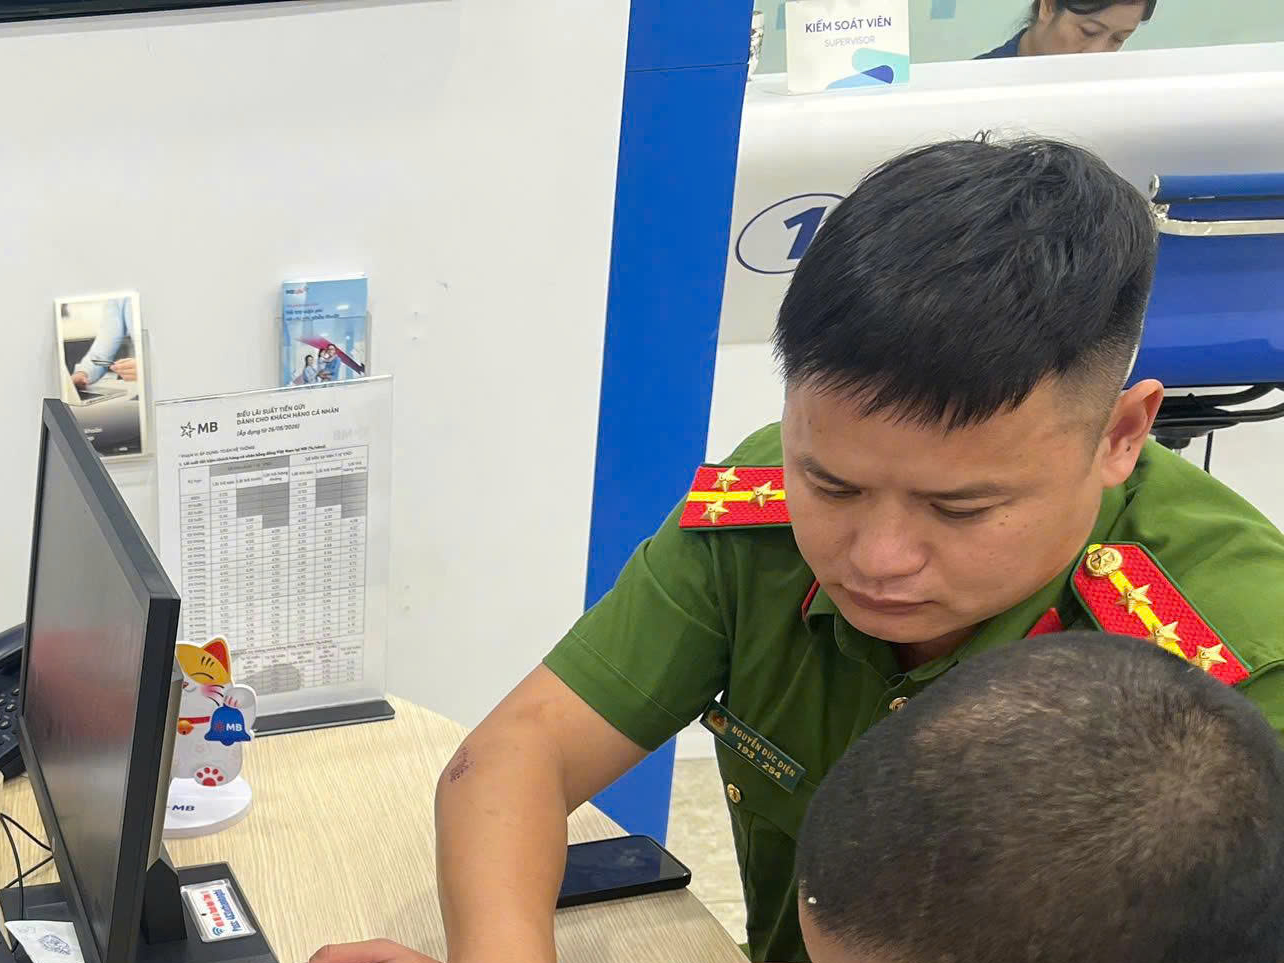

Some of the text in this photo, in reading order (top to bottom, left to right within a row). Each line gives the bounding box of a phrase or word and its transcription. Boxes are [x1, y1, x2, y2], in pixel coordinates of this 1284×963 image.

[805, 15, 892, 33] KIỂM SOÁT VIÊN
[824, 35, 876, 48] SUPERVISOR
[783, 206, 827, 260] 1
[236, 403, 306, 419] BIỂU LÃI SUẤT TIỀN GỬI
[236, 407, 340, 426] DÀNH CHO KHÁCH HÀNG CÁ NHÂN
[197, 422, 219, 435] MB
[225, 721, 243, 732] MB
[731, 726, 762, 751] NGUYỄN
[171, 803, 196, 812] MB
